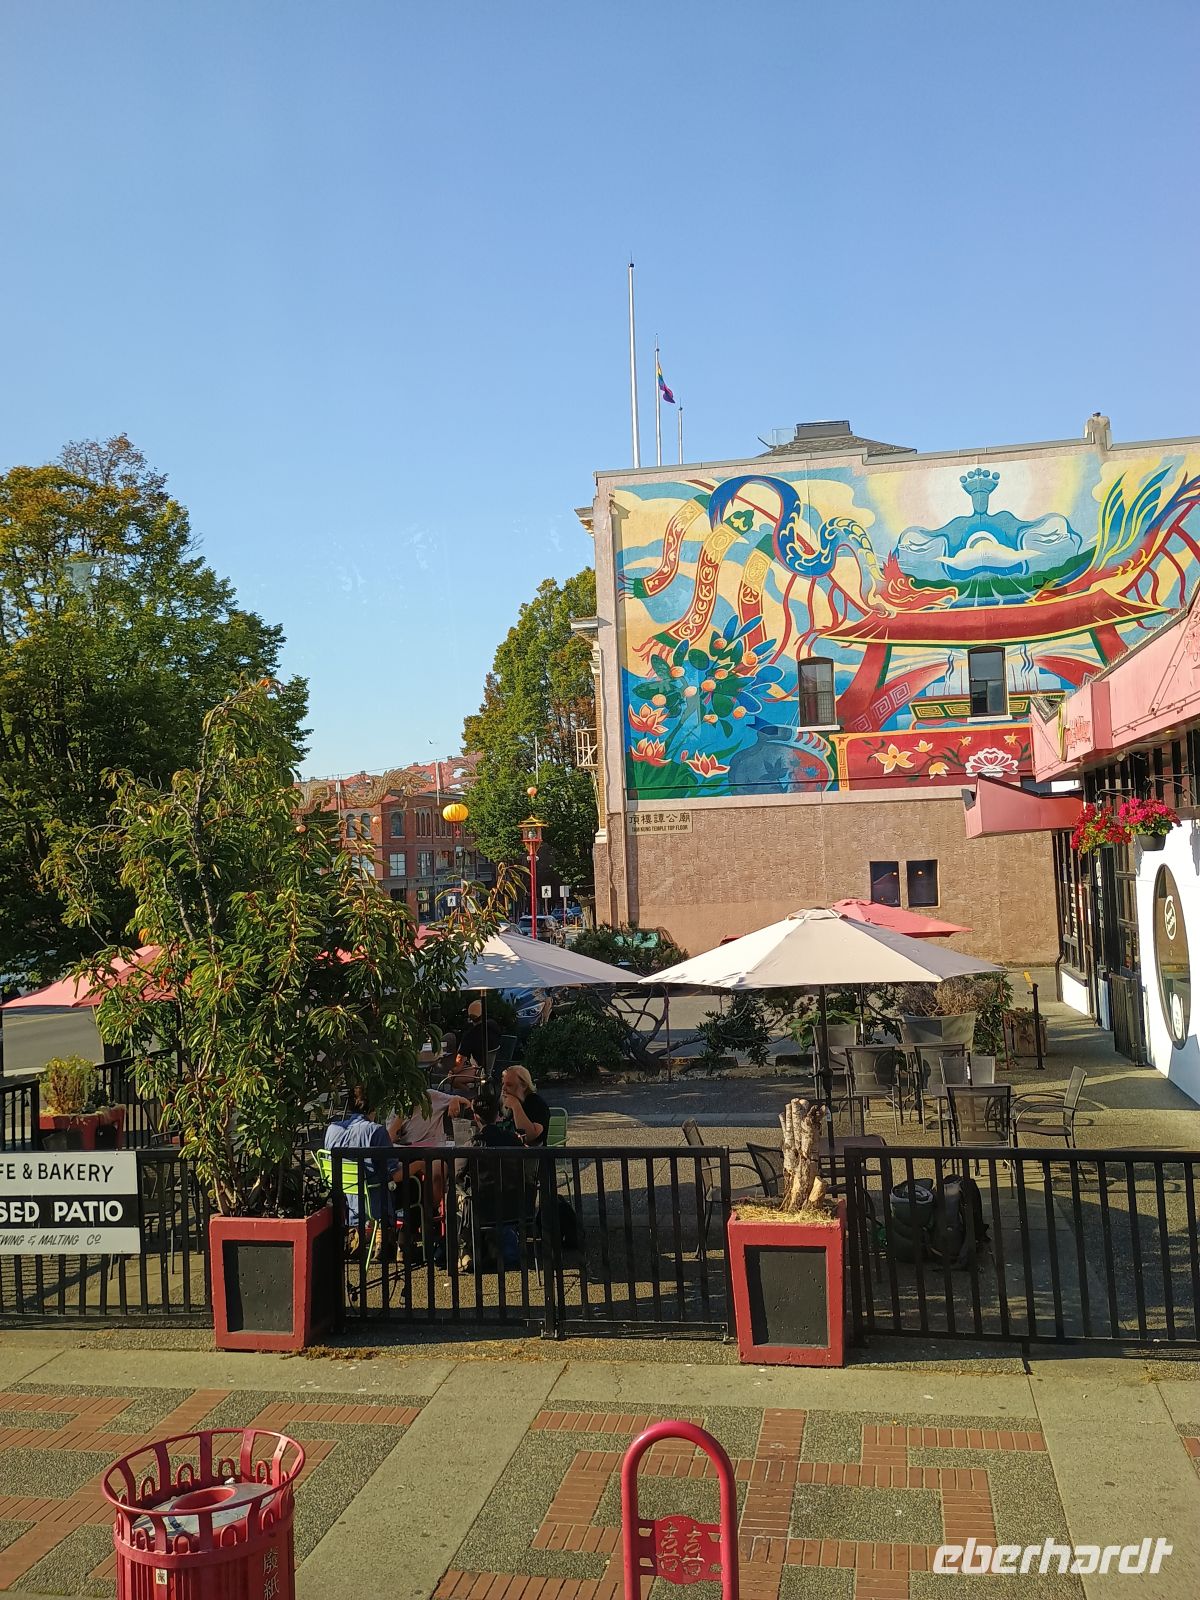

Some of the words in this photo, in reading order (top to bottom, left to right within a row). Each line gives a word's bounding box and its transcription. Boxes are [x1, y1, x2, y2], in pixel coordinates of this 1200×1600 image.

[22, 1162, 33, 1180] &
[38, 1163, 114, 1183] BAKERY
[0, 1201, 40, 1223] SED
[53, 1200, 123, 1222] PATIO
[0, 1234, 25, 1246] WING
[38, 1234, 80, 1246] MALTING
